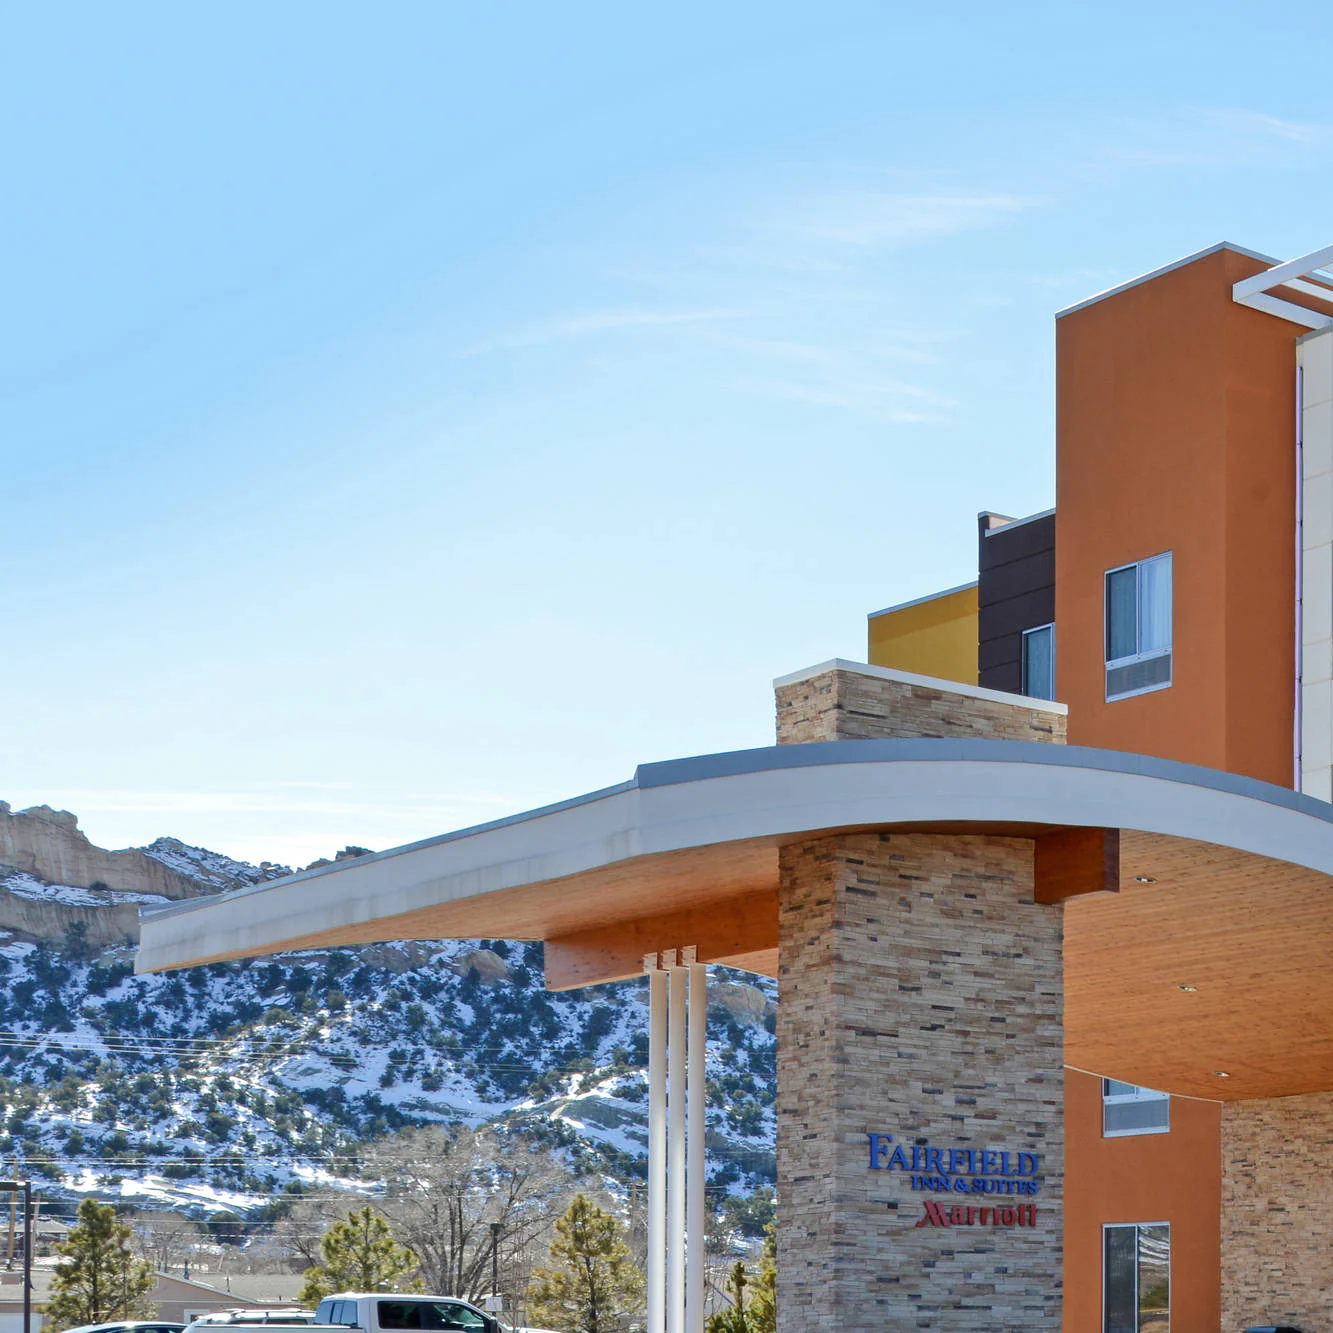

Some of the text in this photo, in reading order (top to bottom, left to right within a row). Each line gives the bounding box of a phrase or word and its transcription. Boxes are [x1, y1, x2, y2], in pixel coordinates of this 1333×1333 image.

[867, 1133, 1040, 1177] FAIRFIELD
[910, 1174, 951, 1192] INN
[972, 1178, 1040, 1196] SUITES
[915, 1199, 1038, 1228] Marriott
